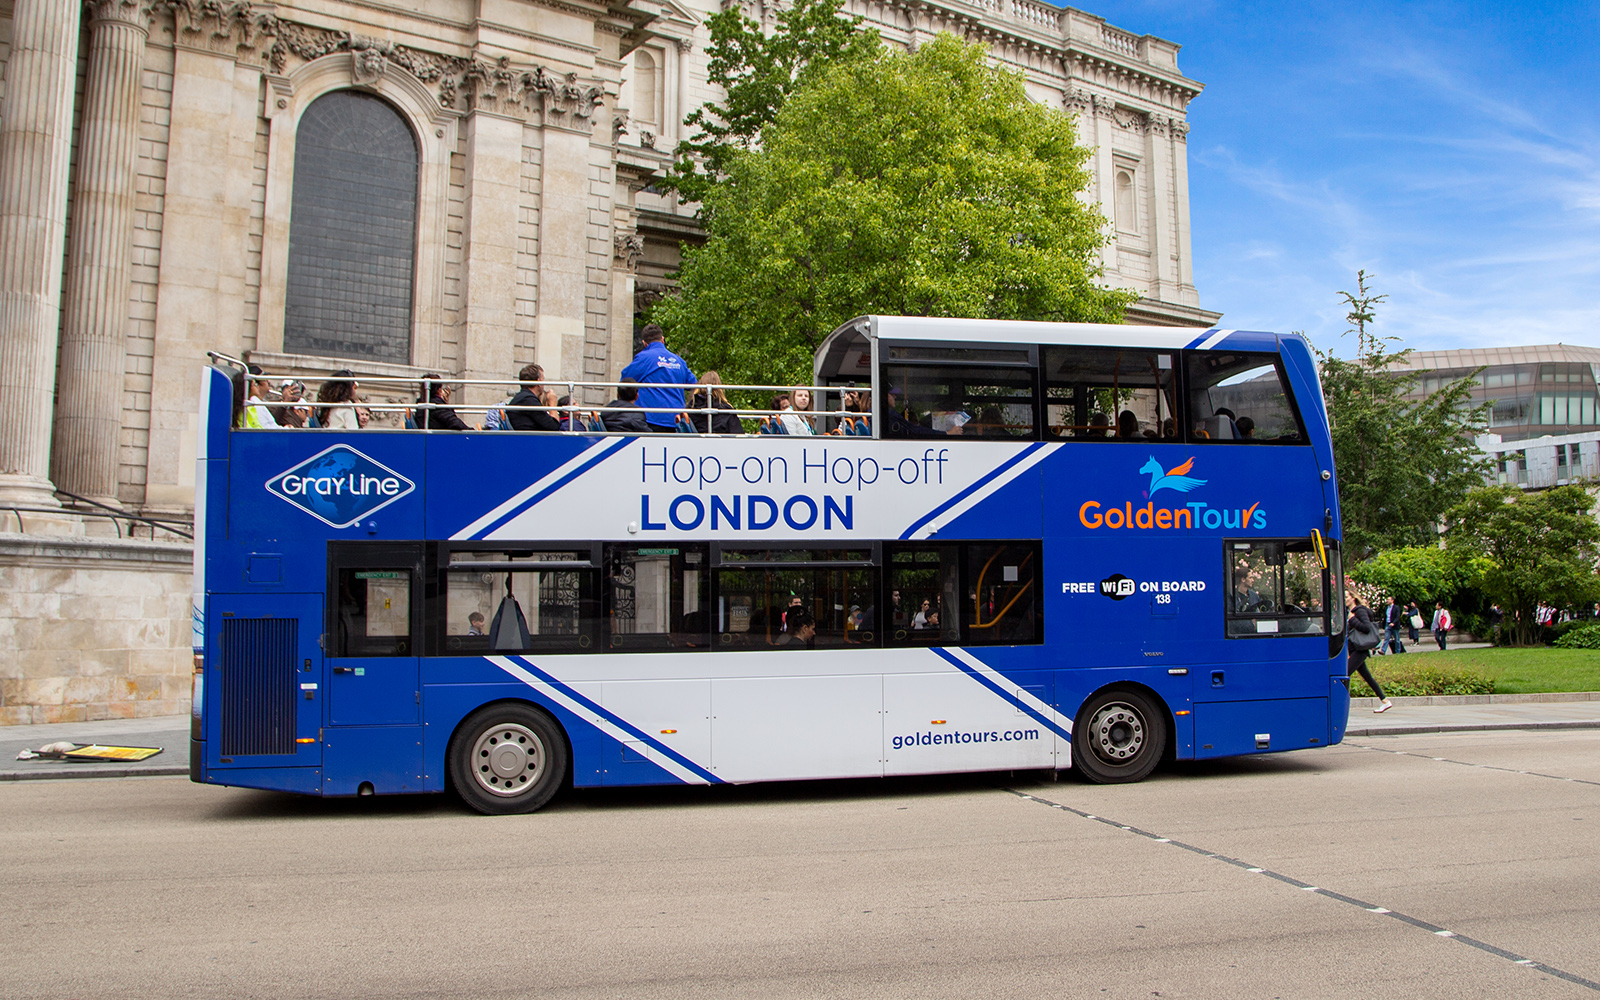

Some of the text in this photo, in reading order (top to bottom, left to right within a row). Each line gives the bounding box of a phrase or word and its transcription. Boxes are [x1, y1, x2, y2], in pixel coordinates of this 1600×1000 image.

[642, 446, 949, 491] Hop-on Hop-off
[281, 473, 400, 495] Gray Line
[641, 494, 853, 531] LONDON
[1079, 500, 1267, 530] GoldenTours
[1062, 582, 1095, 593] FREE
[1139, 581, 1159, 592] ON
[1162, 581, 1206, 592] BOARD
[1155, 594, 1171, 604] 138
[892, 729, 1039, 750] goldentours.com
